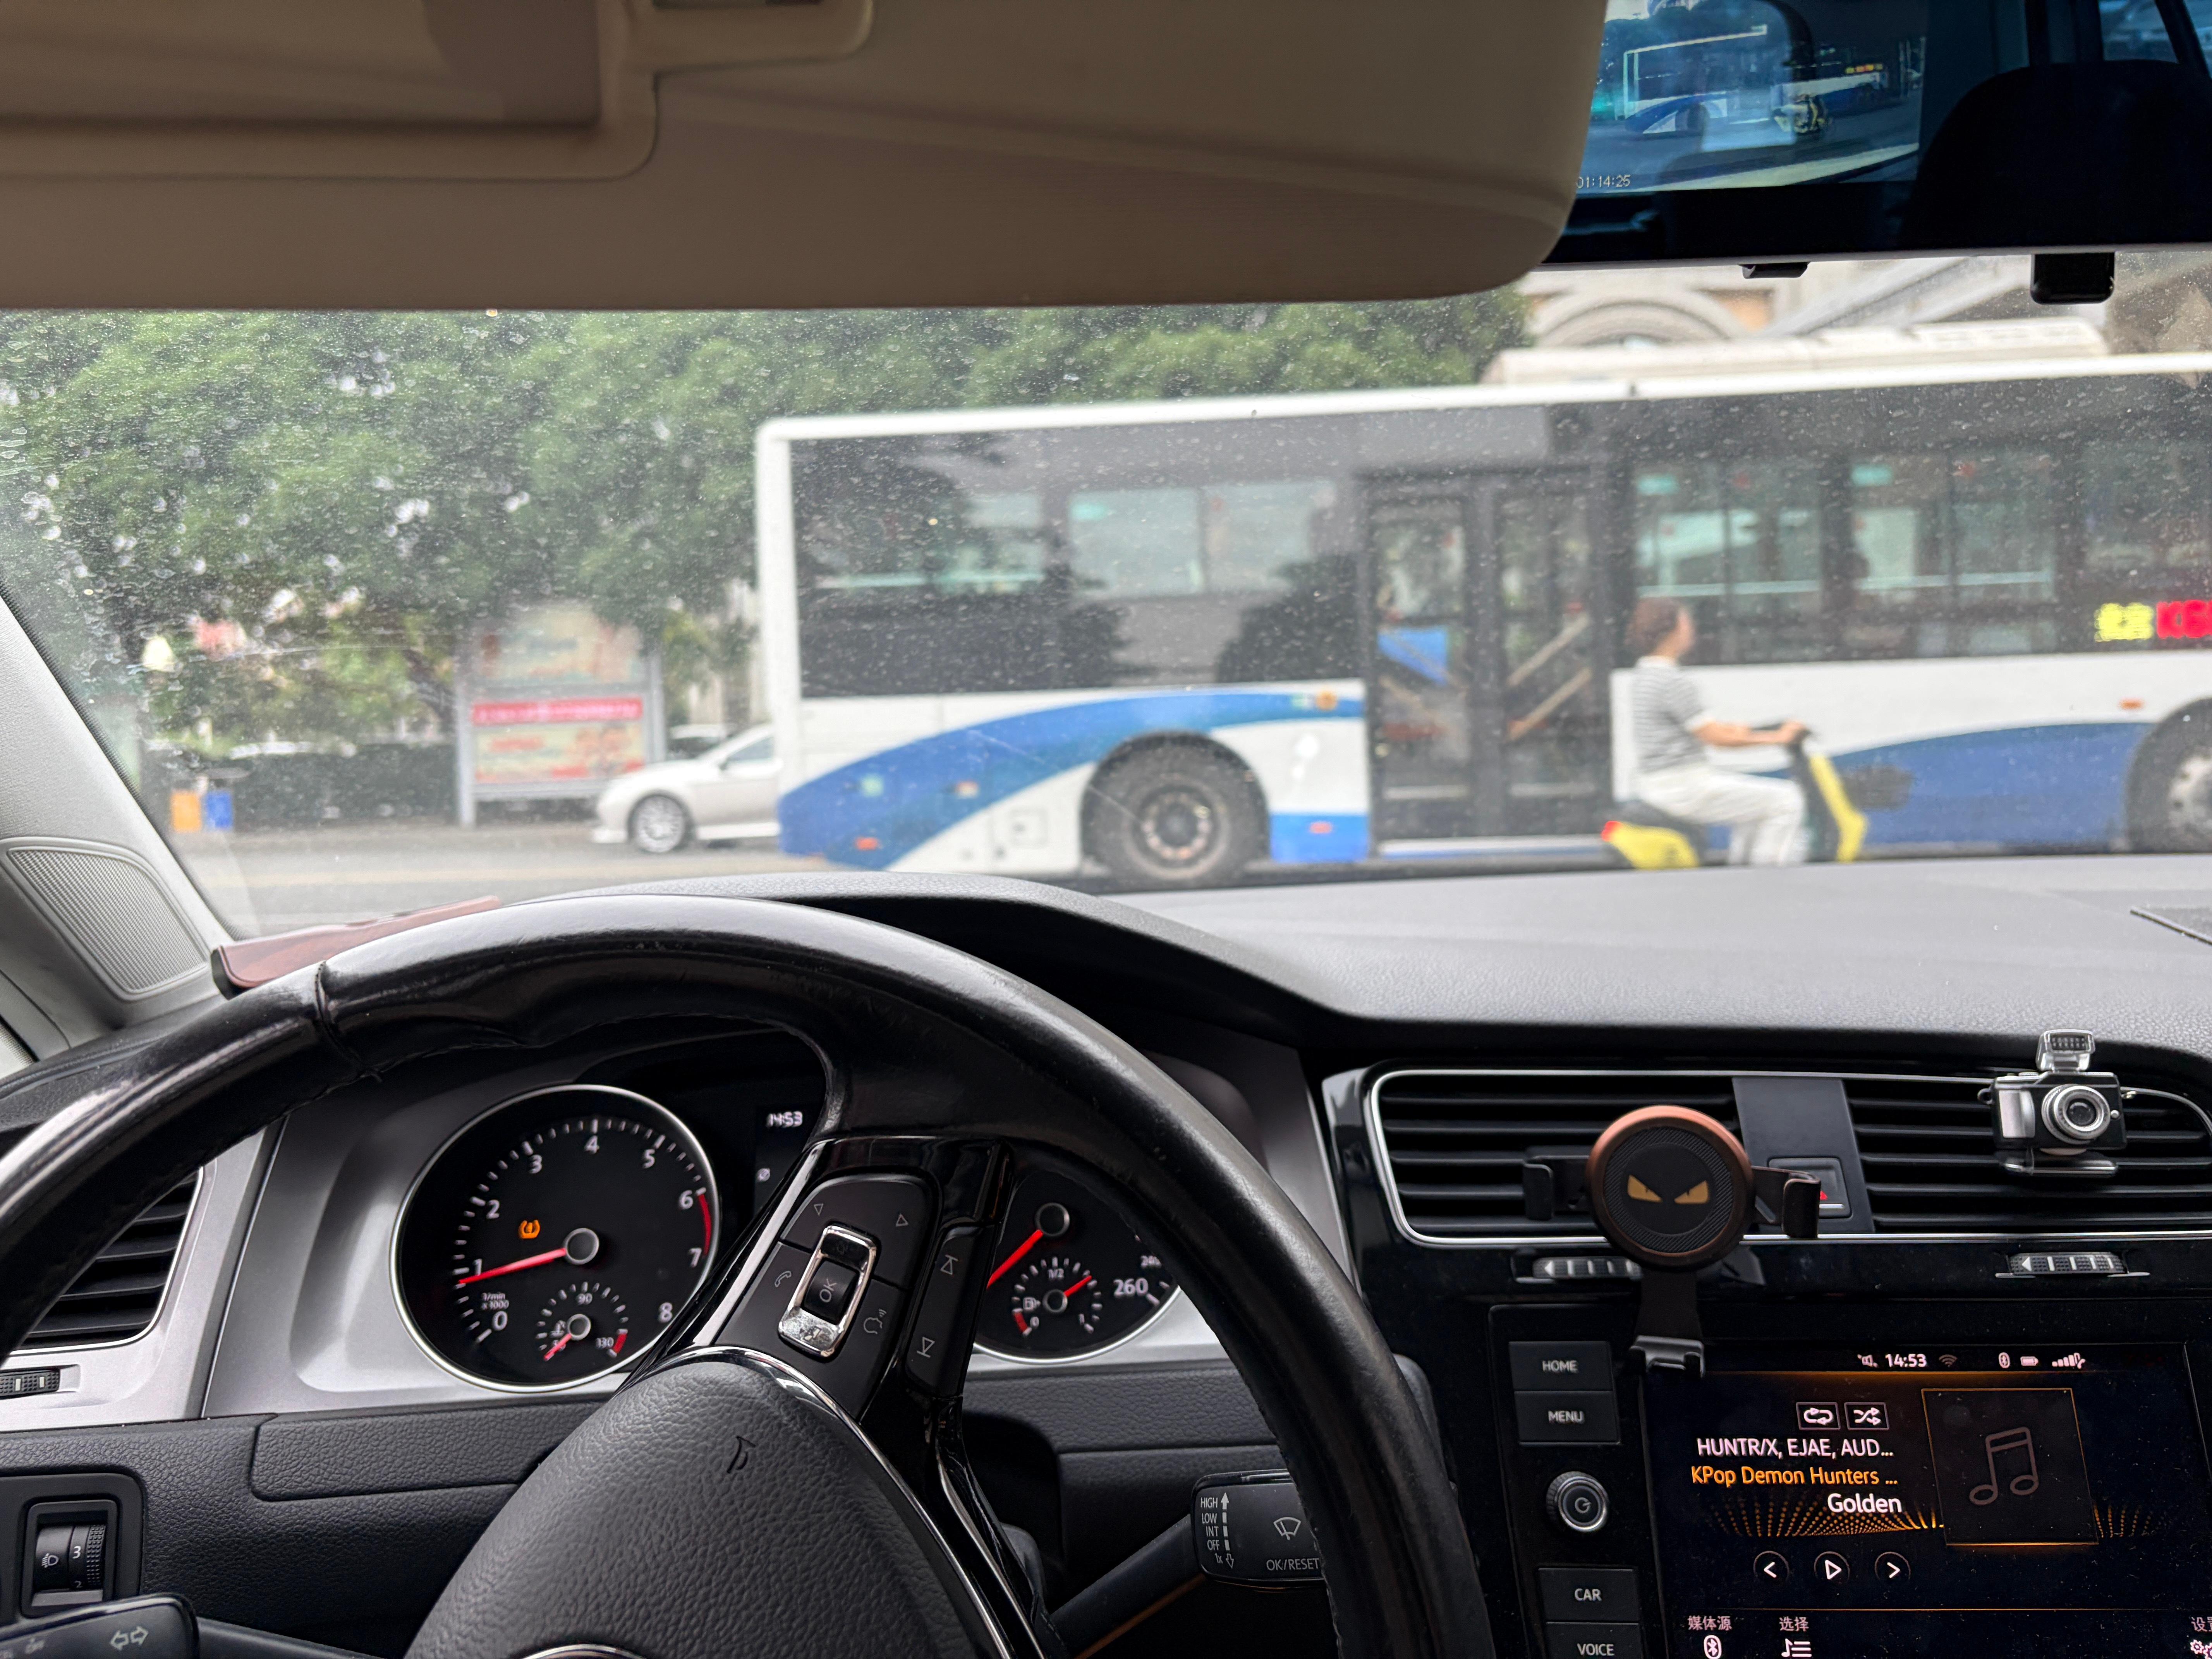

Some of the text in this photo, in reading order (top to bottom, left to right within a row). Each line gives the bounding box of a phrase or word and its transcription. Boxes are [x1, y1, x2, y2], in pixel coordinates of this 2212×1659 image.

[766, 1111, 803, 1128] 14:53
[584, 1135, 599, 1154] 4
[529, 1154, 542, 1174] 3
[643, 1148, 655, 1168] 5
[678, 1190, 694, 1209] 6
[486, 1199, 500, 1219] 2
[690, 1247, 702, 1267] 7
[473, 1258, 482, 1276] 1
[819, 1278, 838, 1303] OK
[1114, 1278, 1149, 1297] 260
[576, 1293, 592, 1305] 90
[493, 1311, 508, 1331] 0
[658, 1302, 673, 1323] 8
[1542, 1360, 1578, 1372] HOME
[1885, 1353, 1927, 1368] 14:53
[1548, 1410, 1584, 1423] MENU
[1697, 1438, 1783, 1460] HUNTR/X,
[1787, 1438, 1836, 1460] EJAE,
[1691, 1466, 1736, 1488] KPop
[1741, 1466, 1805, 1485] Demon
[1810, 1467, 1880, 1485] Hunters
[1200, 1497, 1218, 1508] HIGH
[1827, 1493, 1902, 1514] Golden
[1202, 1513, 1217, 1524] LOW
[1206, 1526, 1219, 1537] INT
[72, 1546, 81, 1559] 3
[1207, 1539, 1220, 1551] OFF
[1266, 1558, 1319, 1571] OK/RESET
[1574, 1588, 1602, 1601] CAR
[1687, 1615, 1732, 1632] 媒体源
[1779, 1616, 1810, 1632] 选择
[1577, 1643, 1614, 1656] VOICE
